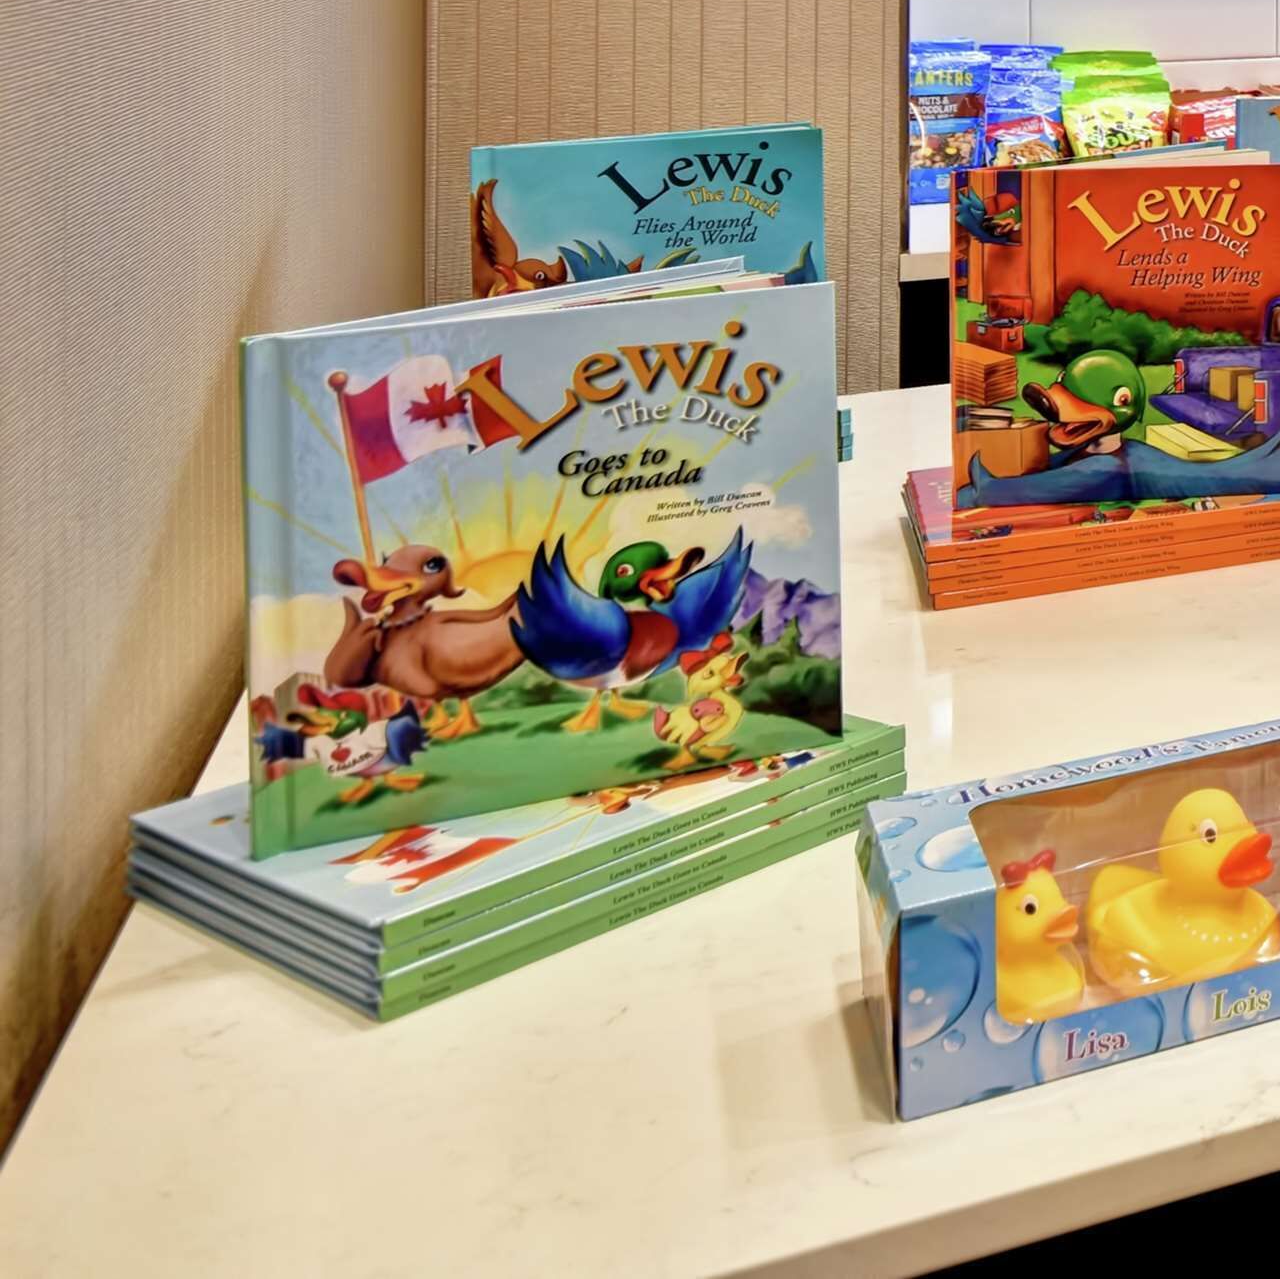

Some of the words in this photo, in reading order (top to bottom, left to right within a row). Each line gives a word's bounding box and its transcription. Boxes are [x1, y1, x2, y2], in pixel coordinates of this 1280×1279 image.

[914, 69, 973, 87] ANTERS
[597, 141, 793, 215] Lewis
[684, 186, 725, 206] The
[730, 186, 780, 219] Duck
[1067, 178, 1265, 251] Lewis
[632, 218, 674, 235] Flies
[680, 211, 754, 233] Around
[664, 232, 694, 249] the
[702, 226, 758, 246] World
[1154, 222, 1195, 243] The
[1200, 223, 1249, 258] Duck
[1116, 248, 1172, 267] Lends
[1176, 252, 1188, 265] a
[1130, 268, 1204, 289] Helping
[1211, 266, 1263, 287] Wing
[454, 321, 781, 451] Lewis
[602, 398, 675, 431] The
[680, 395, 760, 443] Duck
[558, 449, 628, 478] Goes
[641, 448, 667, 468] to
[581, 459, 704, 497] Canada
[958, 743, 1182, 803] Homewood's
[1211, 986, 1272, 1022] Lois
[1063, 1027, 1129, 1062] Lisa
